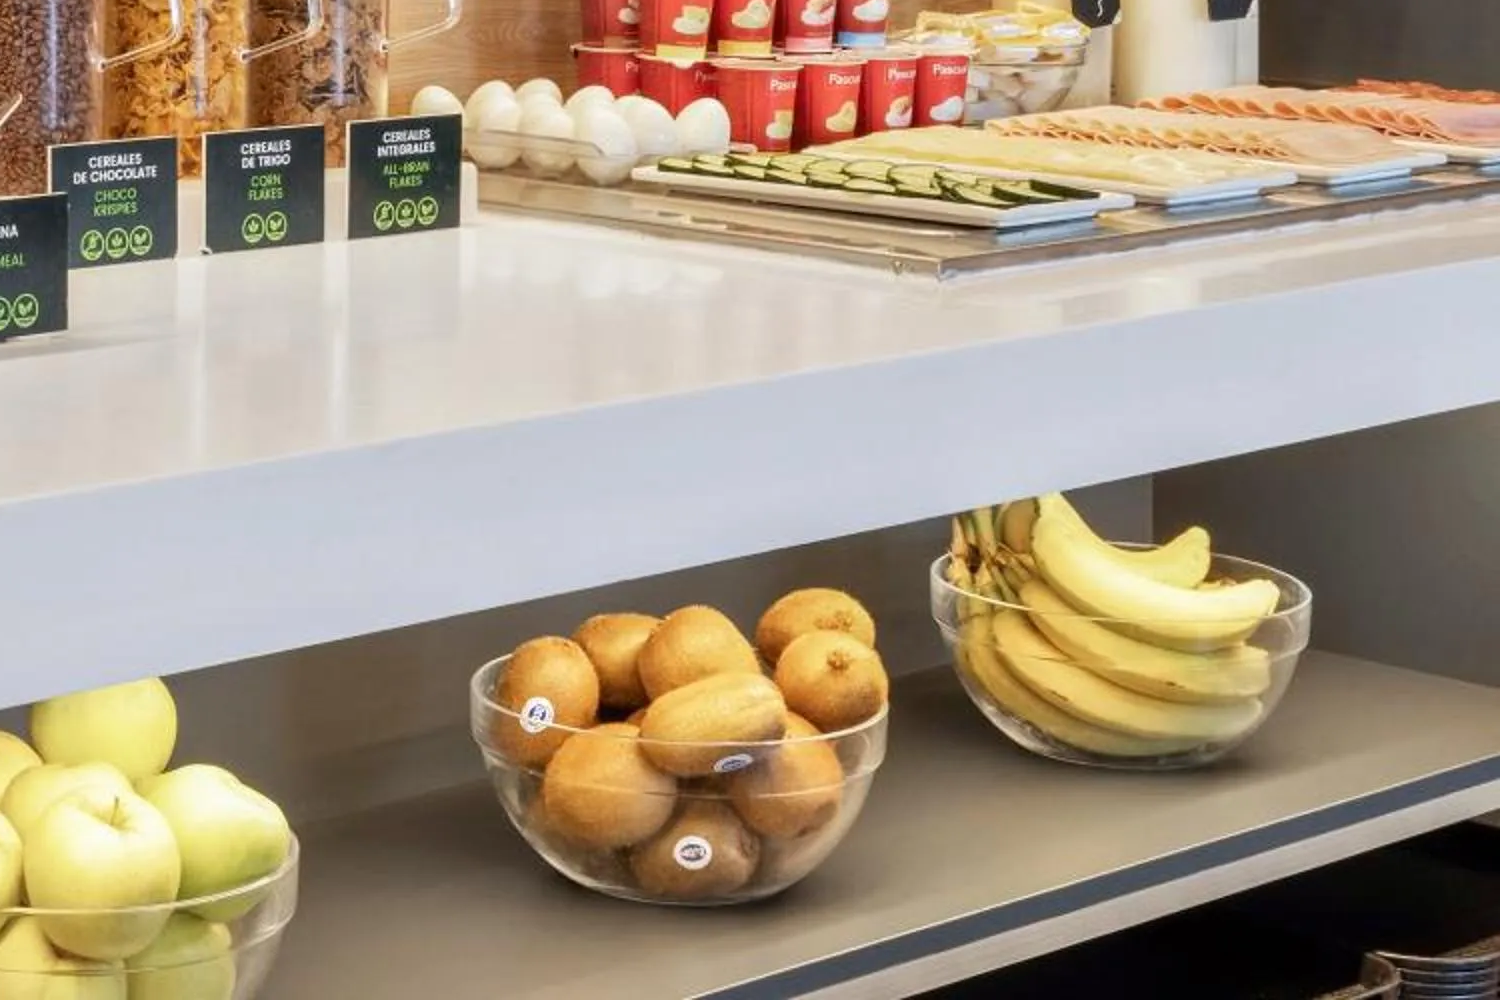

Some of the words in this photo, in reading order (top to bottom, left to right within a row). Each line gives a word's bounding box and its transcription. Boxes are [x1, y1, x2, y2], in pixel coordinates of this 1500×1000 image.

[383, 128, 431, 143] CEREALES
[241, 140, 292, 155] CEREALES
[377, 141, 436, 157] INTEGRALES
[88, 153, 143, 168] CEREALES
[241, 157, 255, 169] DE
[258, 154, 291, 167] TRIGO
[72, 171, 88, 185] DE
[90, 165, 158, 182] CHOCOLATE
[251, 174, 281, 187] CORN
[95, 187, 137, 202] CHOCO
